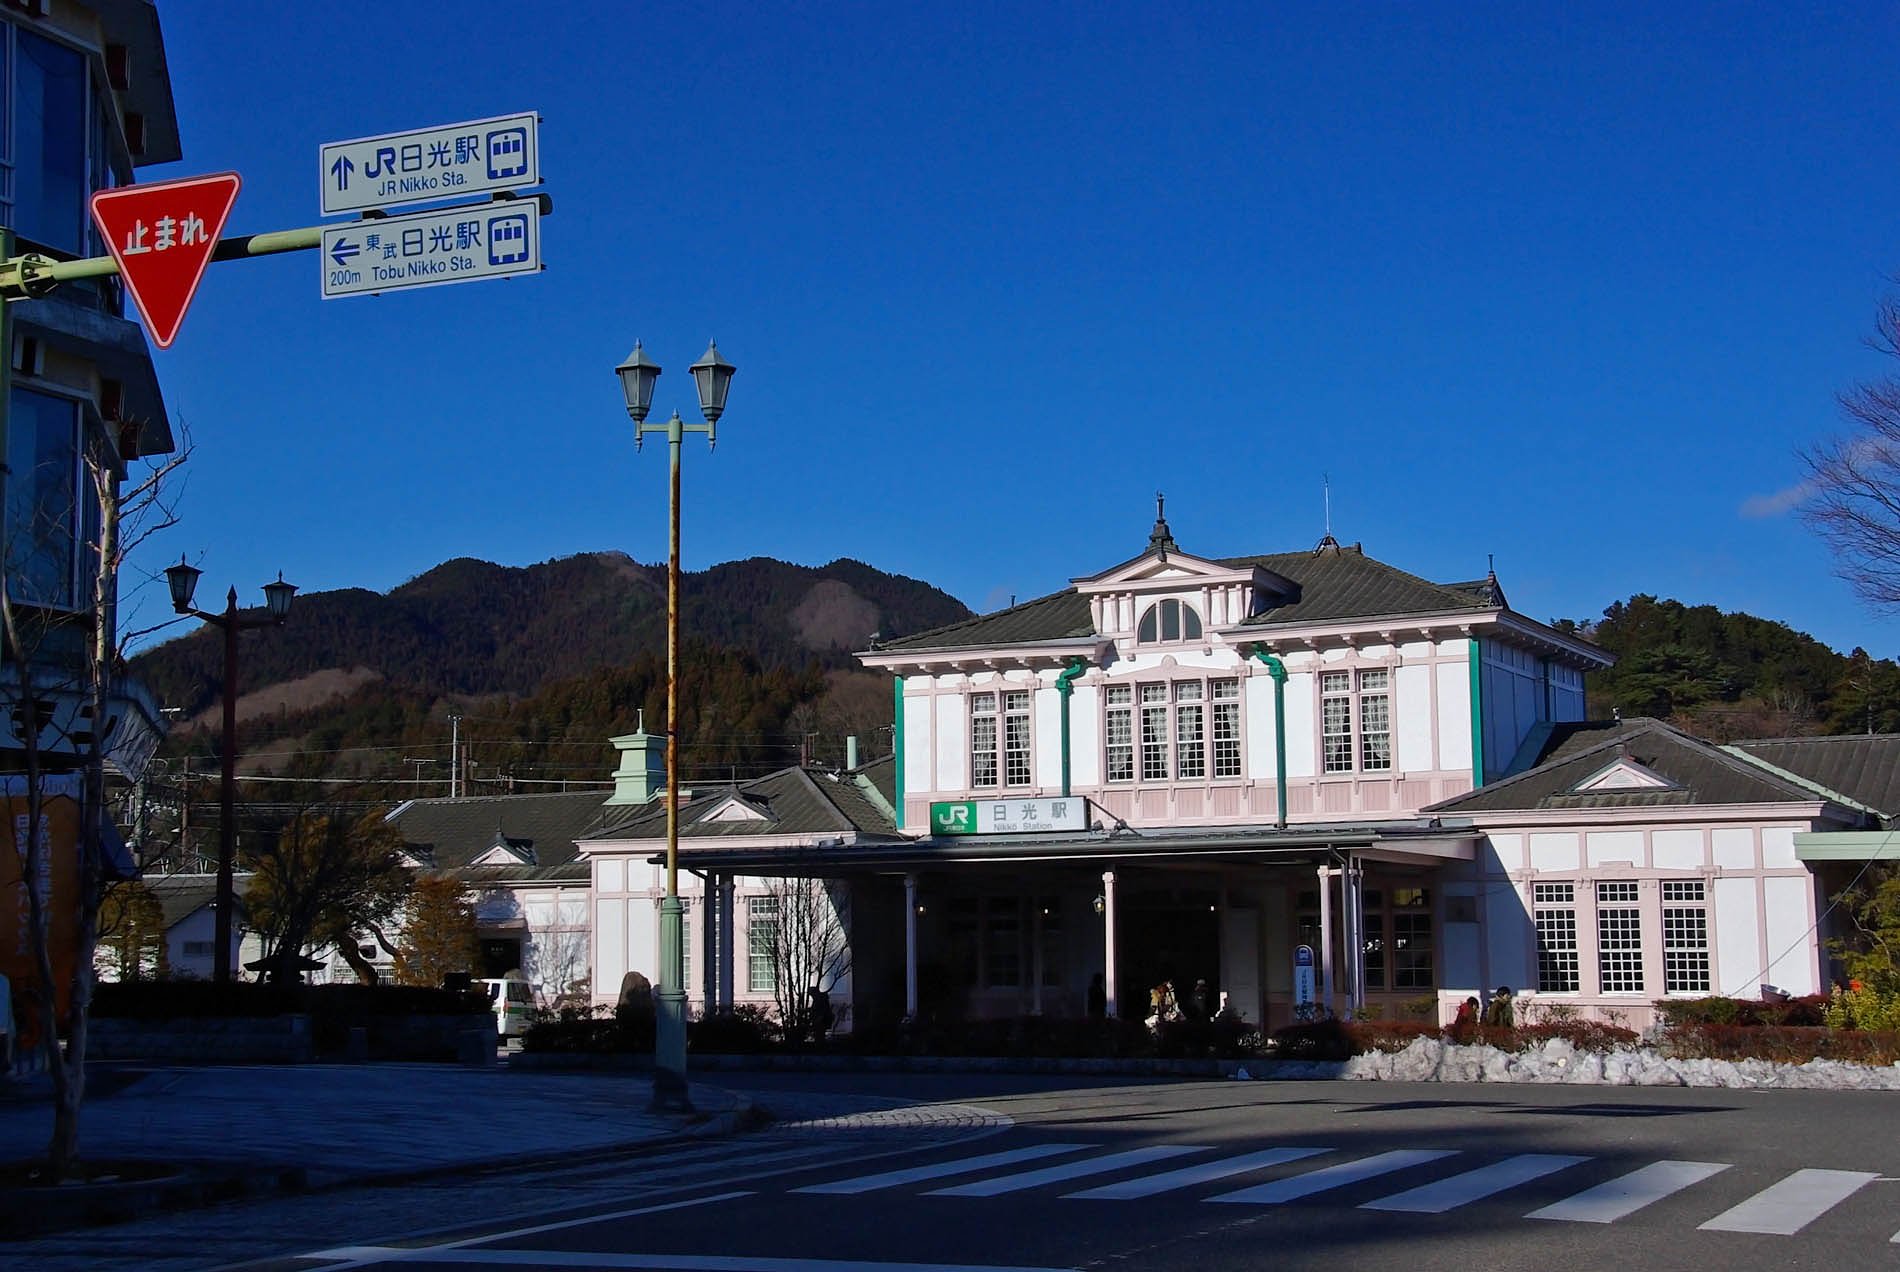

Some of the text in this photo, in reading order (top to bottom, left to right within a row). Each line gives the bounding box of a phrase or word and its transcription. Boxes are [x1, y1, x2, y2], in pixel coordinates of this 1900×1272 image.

[364, 134, 481, 179] JR日光駅
[378, 172, 468, 197] JR Nikko Sta.
[122, 211, 209, 256] 止まれ
[330, 270, 361, 287] 200m
[372, 257, 477, 282] Tobu Nikko Sta.
[939, 805, 969, 825] JR
[993, 801, 1067, 821] 日光駅
[1022, 821, 1053, 831] Station
